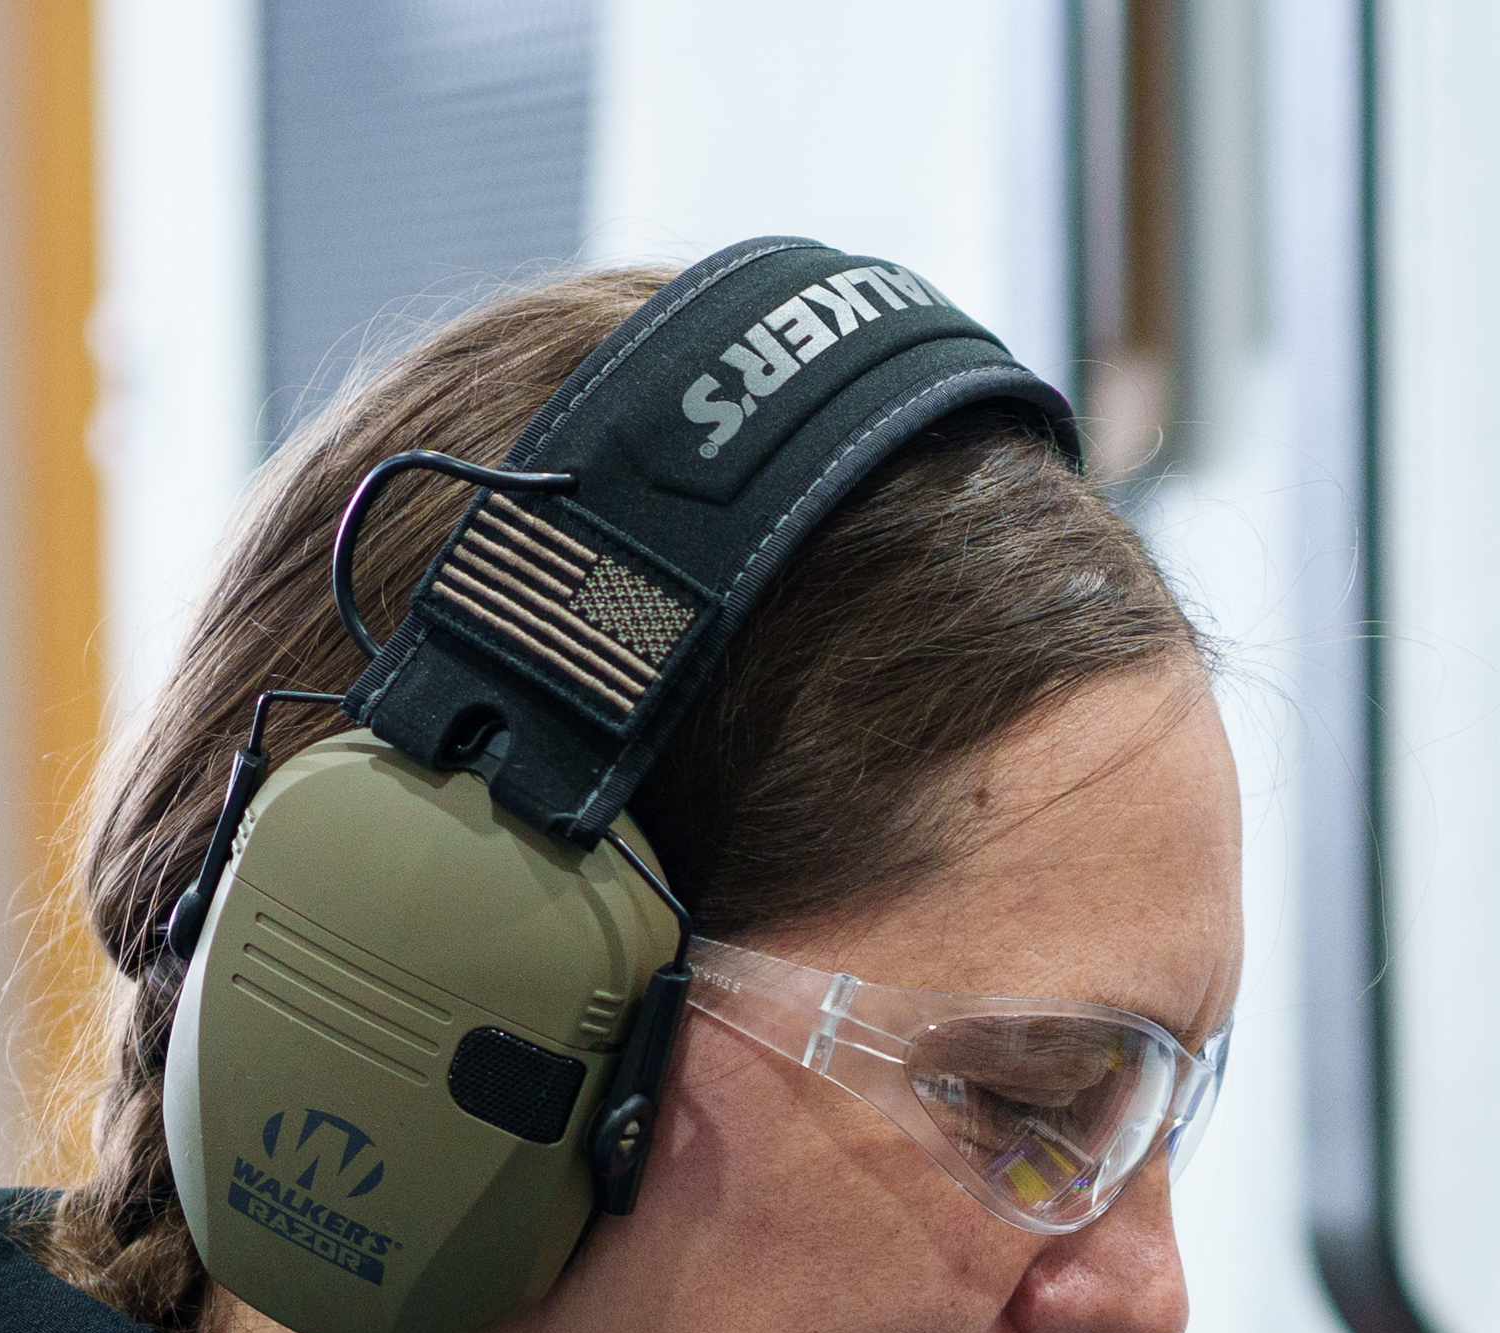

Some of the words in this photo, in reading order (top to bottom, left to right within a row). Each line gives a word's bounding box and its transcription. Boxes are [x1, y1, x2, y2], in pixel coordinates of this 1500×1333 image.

[682, 265, 950, 447] ALKER'S
[233, 1156, 393, 1256] WALKER'S
[247, 1197, 361, 1273] RAZOR
